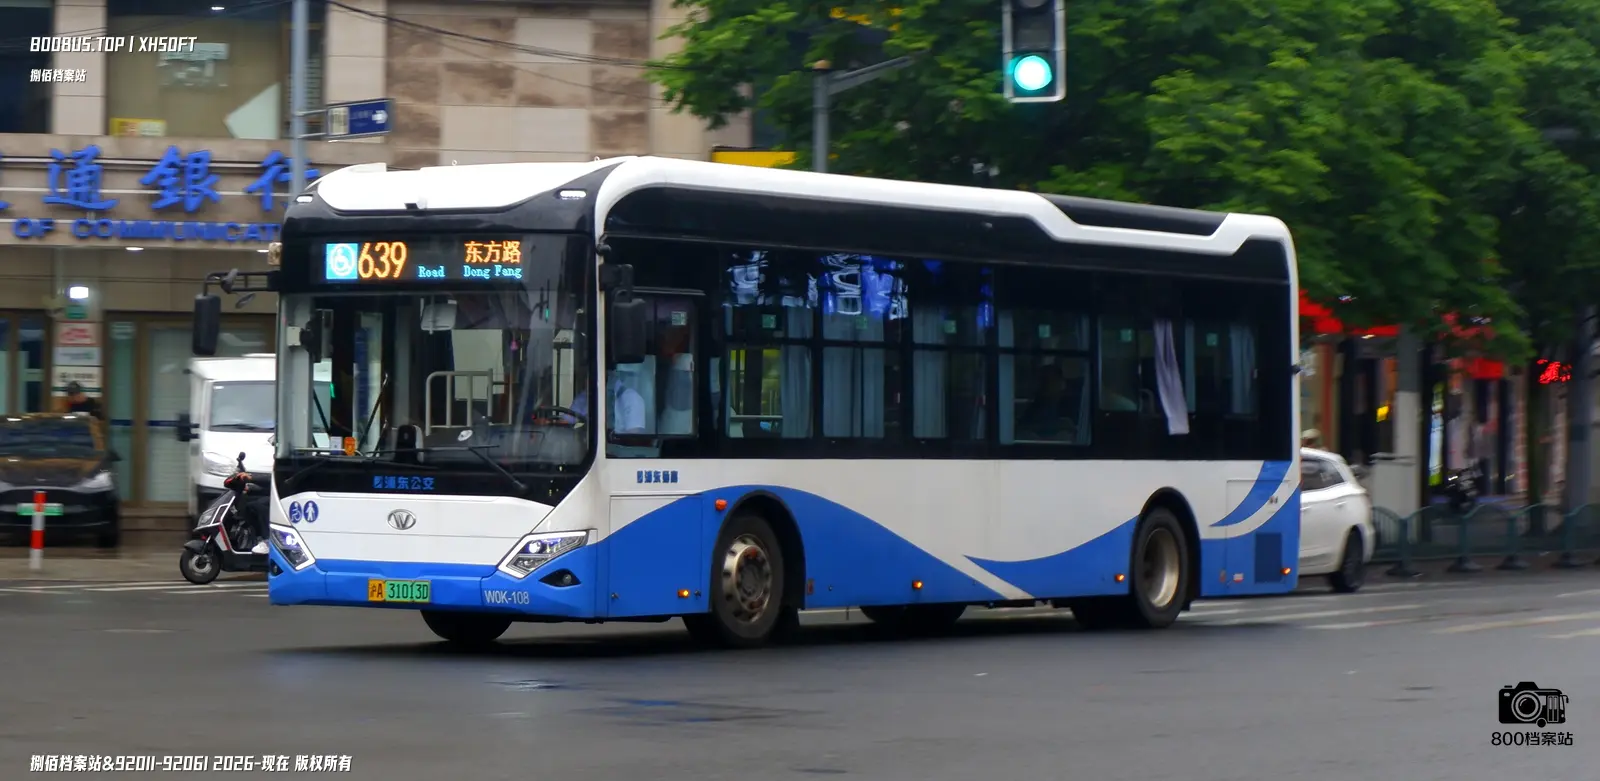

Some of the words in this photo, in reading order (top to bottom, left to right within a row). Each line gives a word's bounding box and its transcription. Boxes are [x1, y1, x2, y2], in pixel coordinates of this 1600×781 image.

[0, 144, 320, 212] 通銀行
[13, 217, 55, 239] OF
[358, 241, 408, 279] 639
[464, 240, 522, 264] 东方路
[418, 265, 446, 279] Road
[463, 265, 490, 279] Dong
[494, 265, 522, 279] Fang
[384, 475, 435, 490] 浦东公交
